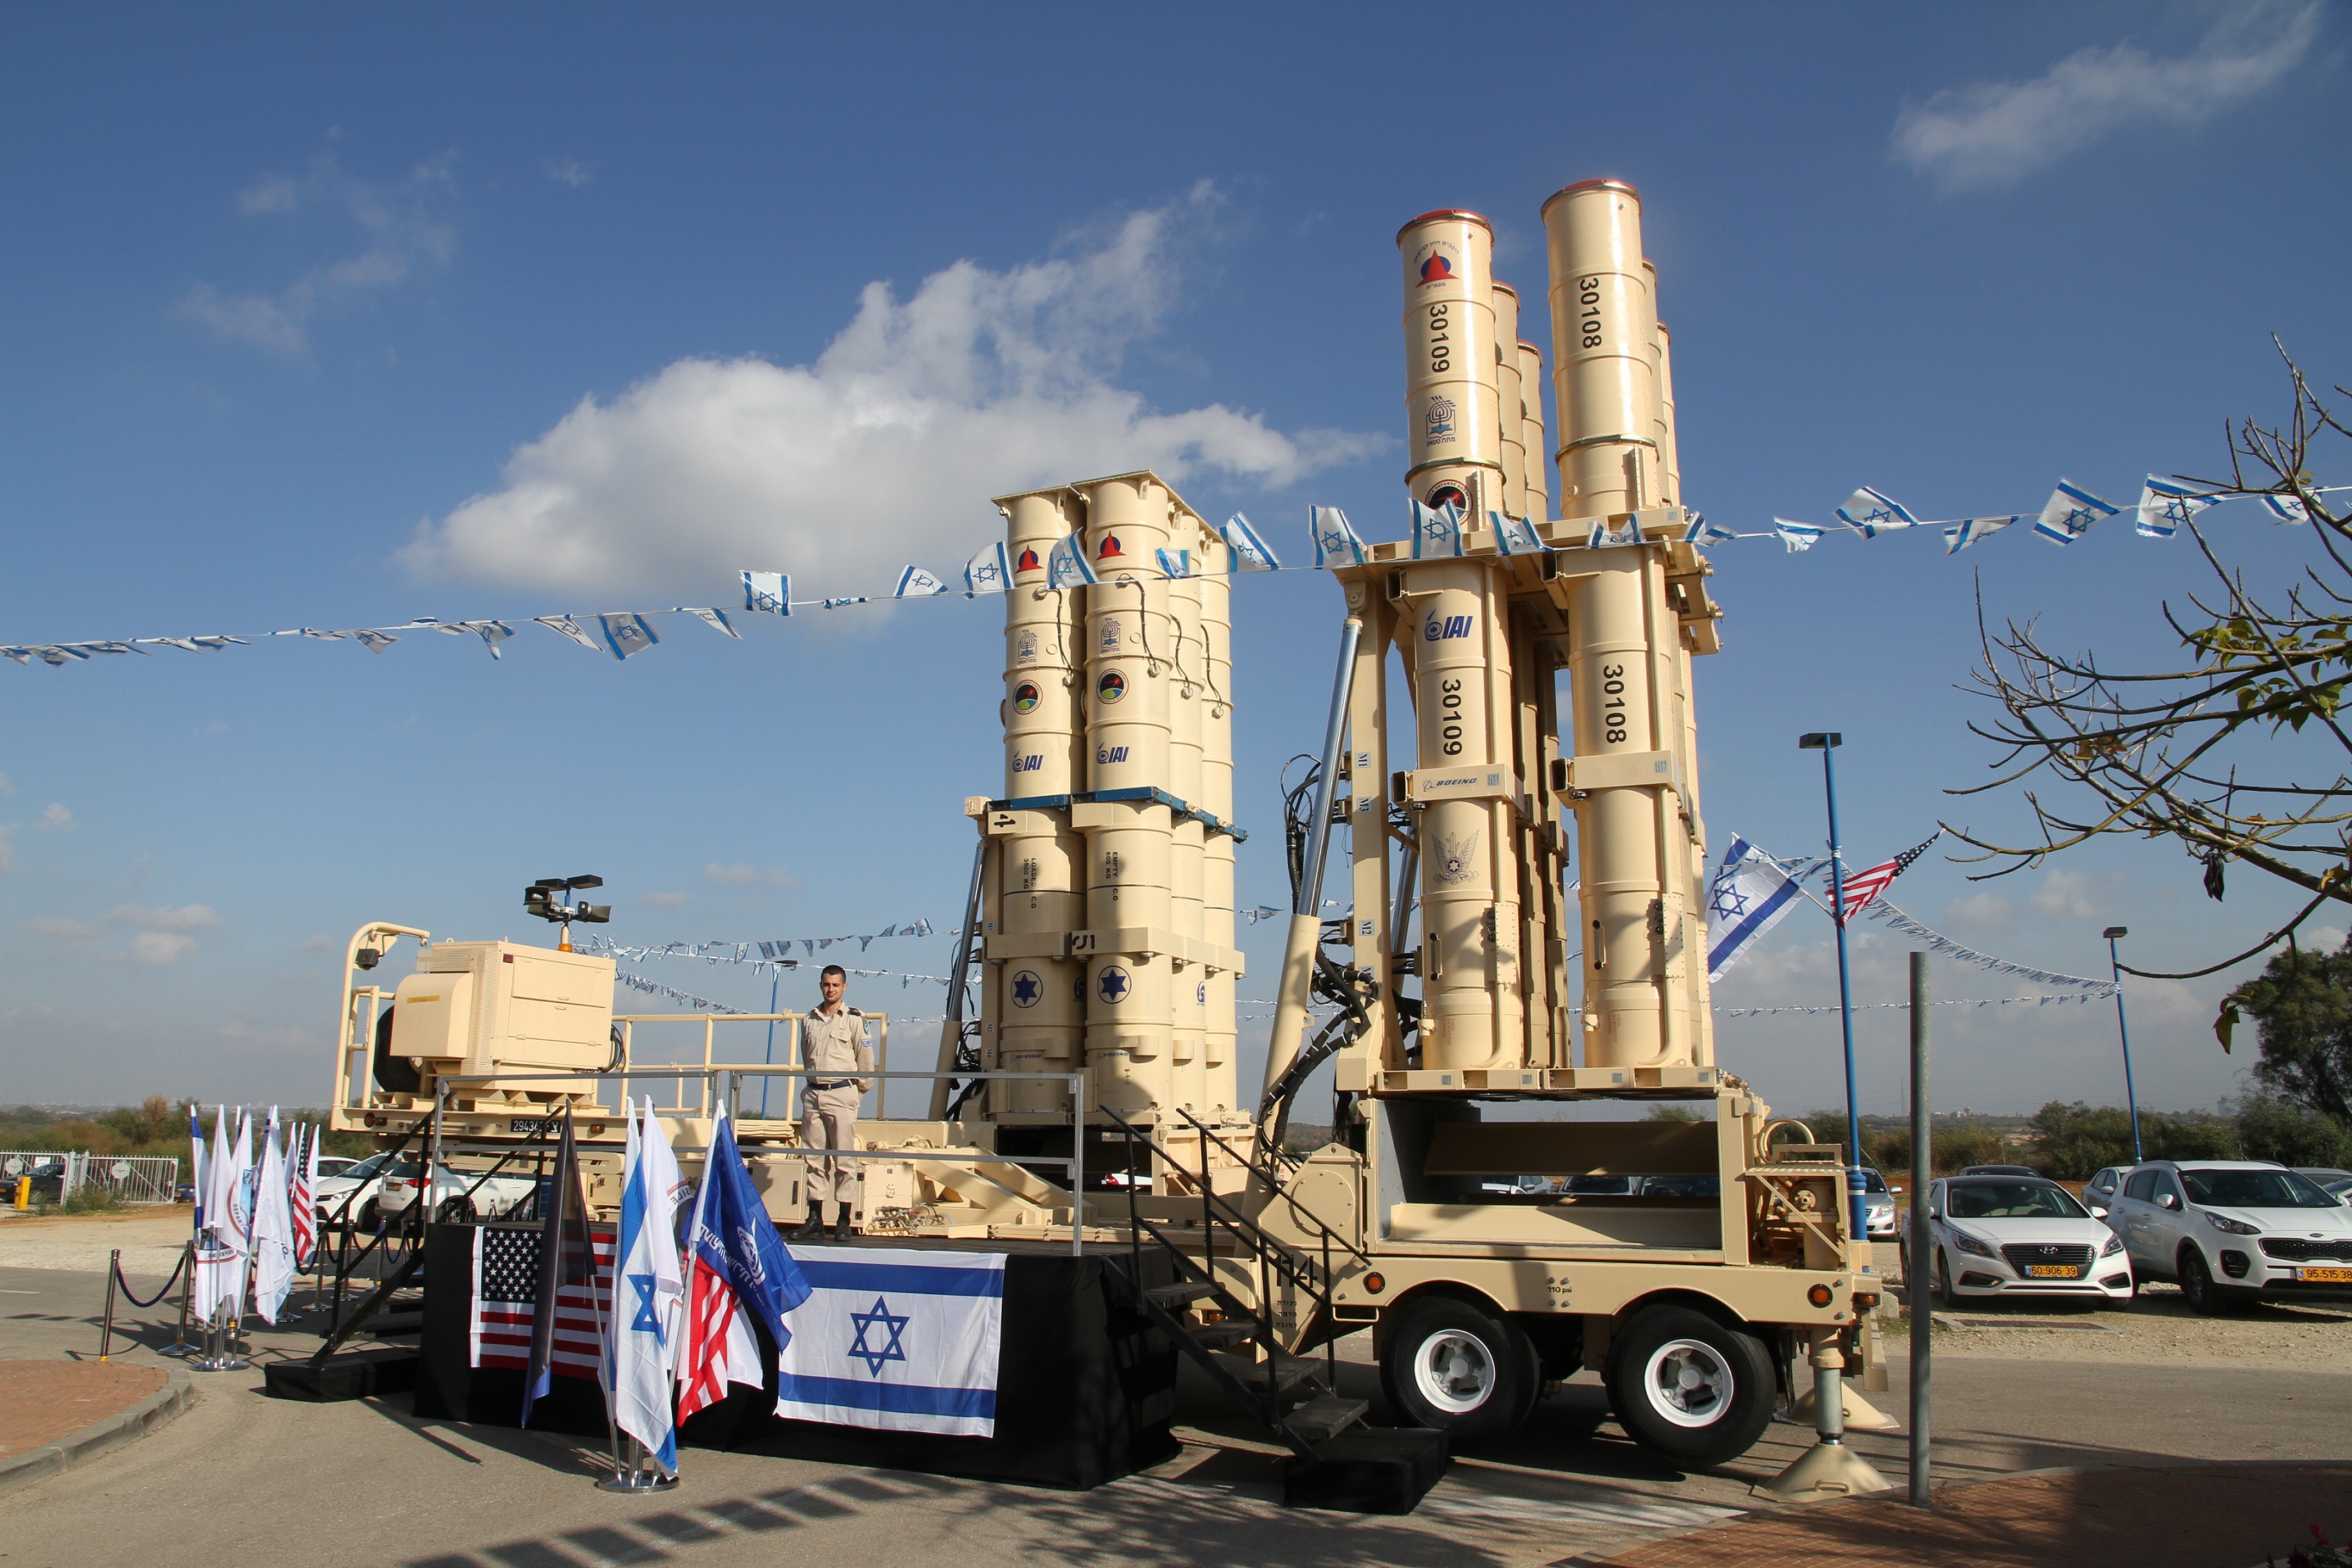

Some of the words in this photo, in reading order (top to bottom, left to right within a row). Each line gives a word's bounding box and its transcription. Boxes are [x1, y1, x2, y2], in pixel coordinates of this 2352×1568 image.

[1579, 277, 1602, 349] 30108
[1429, 304, 1450, 373] 30109
[1441, 616, 1473, 640] IAI
[1603, 664, 1627, 744] 30108
[1442, 678, 1463, 756] 30109
[1023, 755, 1044, 771] IAI
[1108, 747, 1129, 763] IAI
[1358, 754, 1368, 767] M1
[1436, 778, 1477, 786] BOEING
[1359, 798, 1370, 812] M3
[1106, 868, 1111, 879] KG
[1023, 879, 1029, 889] KG
[1361, 921, 1372, 935] M2
